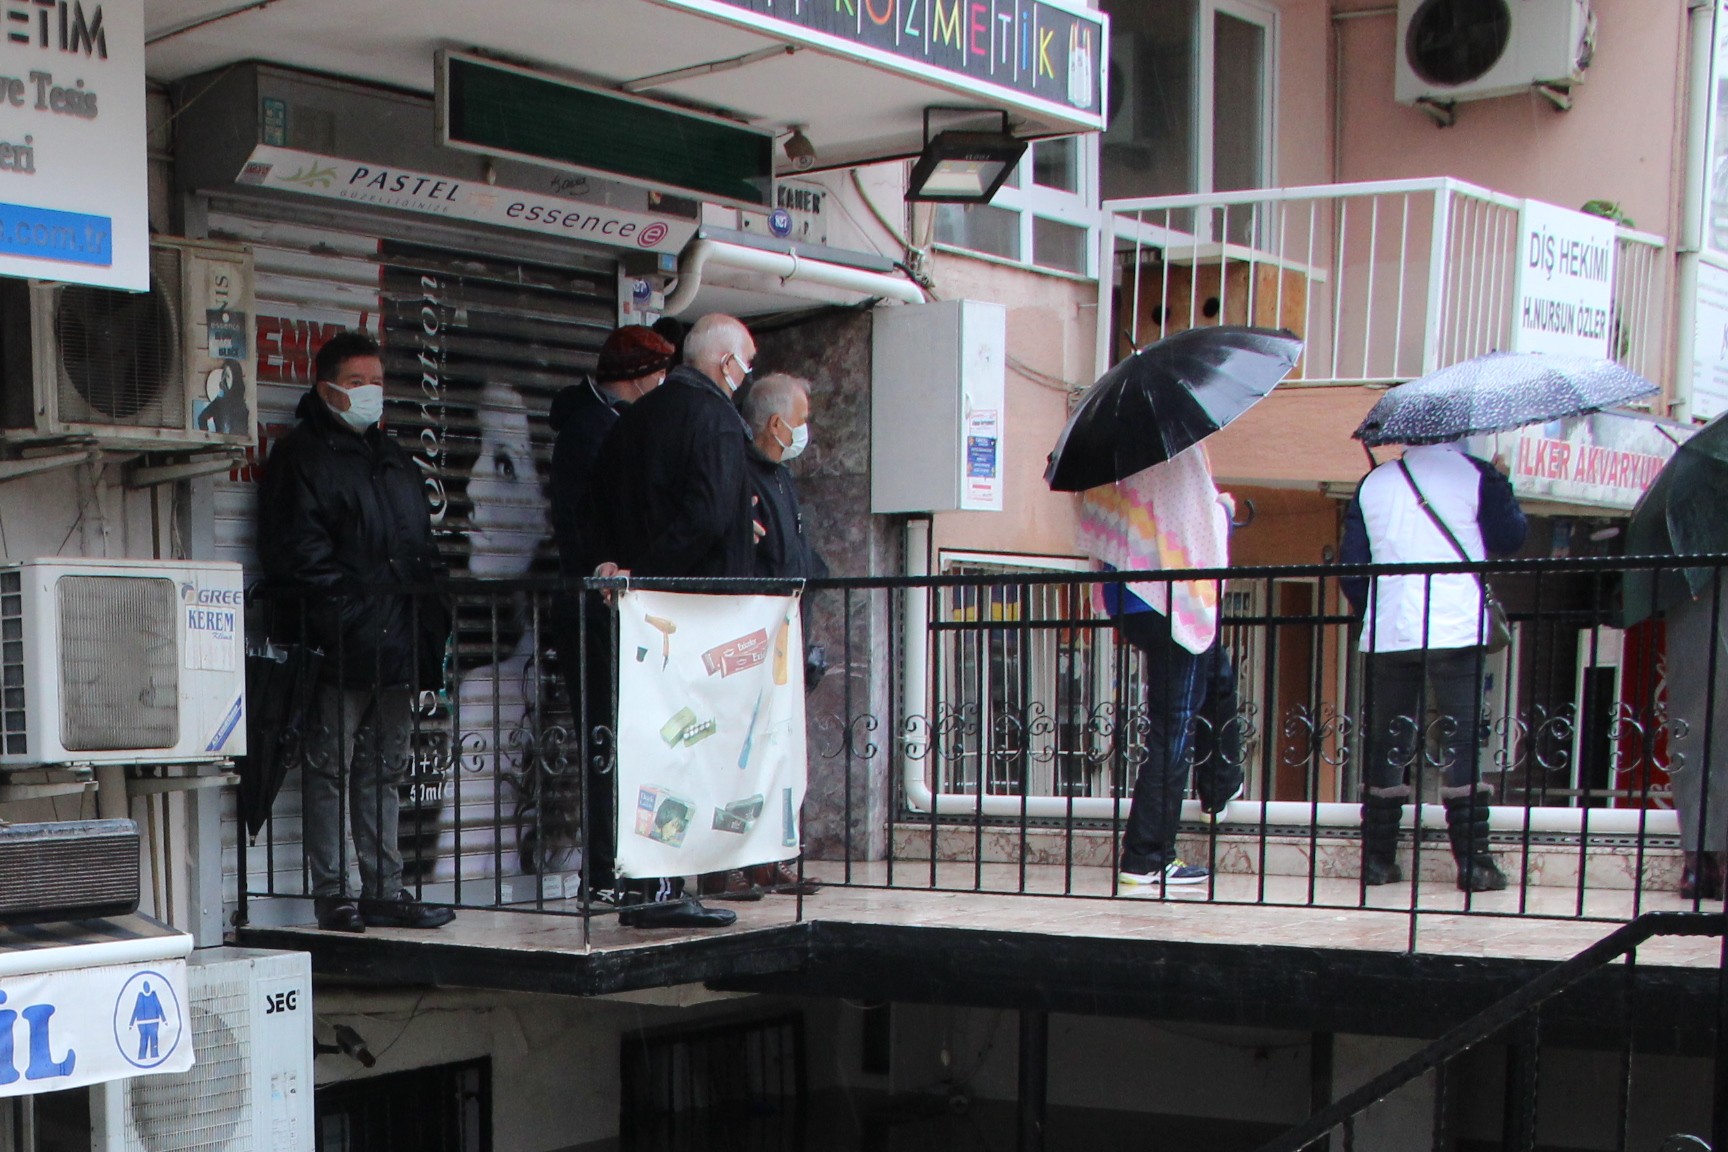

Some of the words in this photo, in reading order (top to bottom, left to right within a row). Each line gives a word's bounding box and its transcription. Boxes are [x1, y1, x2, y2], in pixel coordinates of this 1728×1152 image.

[29, 70, 99, 119] Tesis
[348, 167, 460, 202] PASTEL
[506, 199, 637, 239] essence
[1529, 225, 1555, 280] DİŞ
[1559, 236, 1610, 283] HEKİMİ
[198, 588, 243, 605] GREE
[188, 609, 234, 632] KEREM
[266, 990, 296, 1014] SEG
